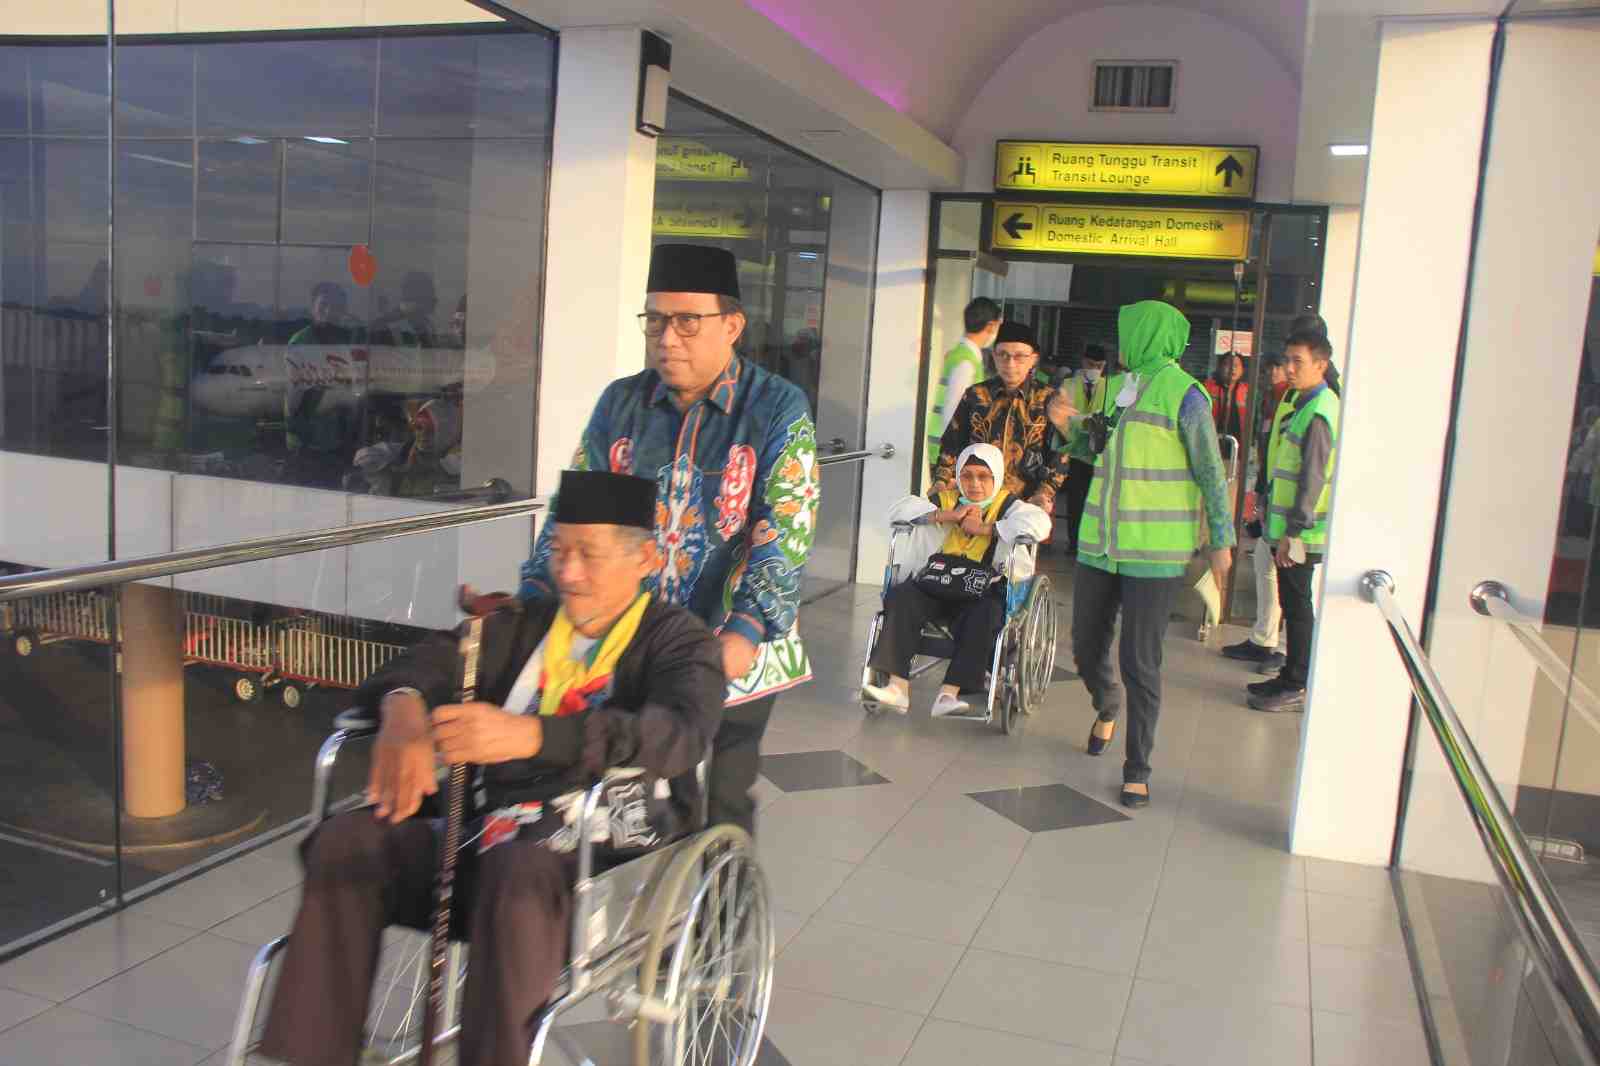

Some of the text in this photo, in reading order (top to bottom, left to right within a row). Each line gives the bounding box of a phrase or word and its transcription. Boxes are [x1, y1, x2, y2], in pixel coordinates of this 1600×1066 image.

[1052, 152, 1197, 169] Ruang Tunggu Transit
[1052, 170, 1150, 187] Transit Lounge
[1048, 213, 1224, 232] Ruang Kedatangan Domestik
[1048, 230, 1177, 248] Domestic Arrival Hall
